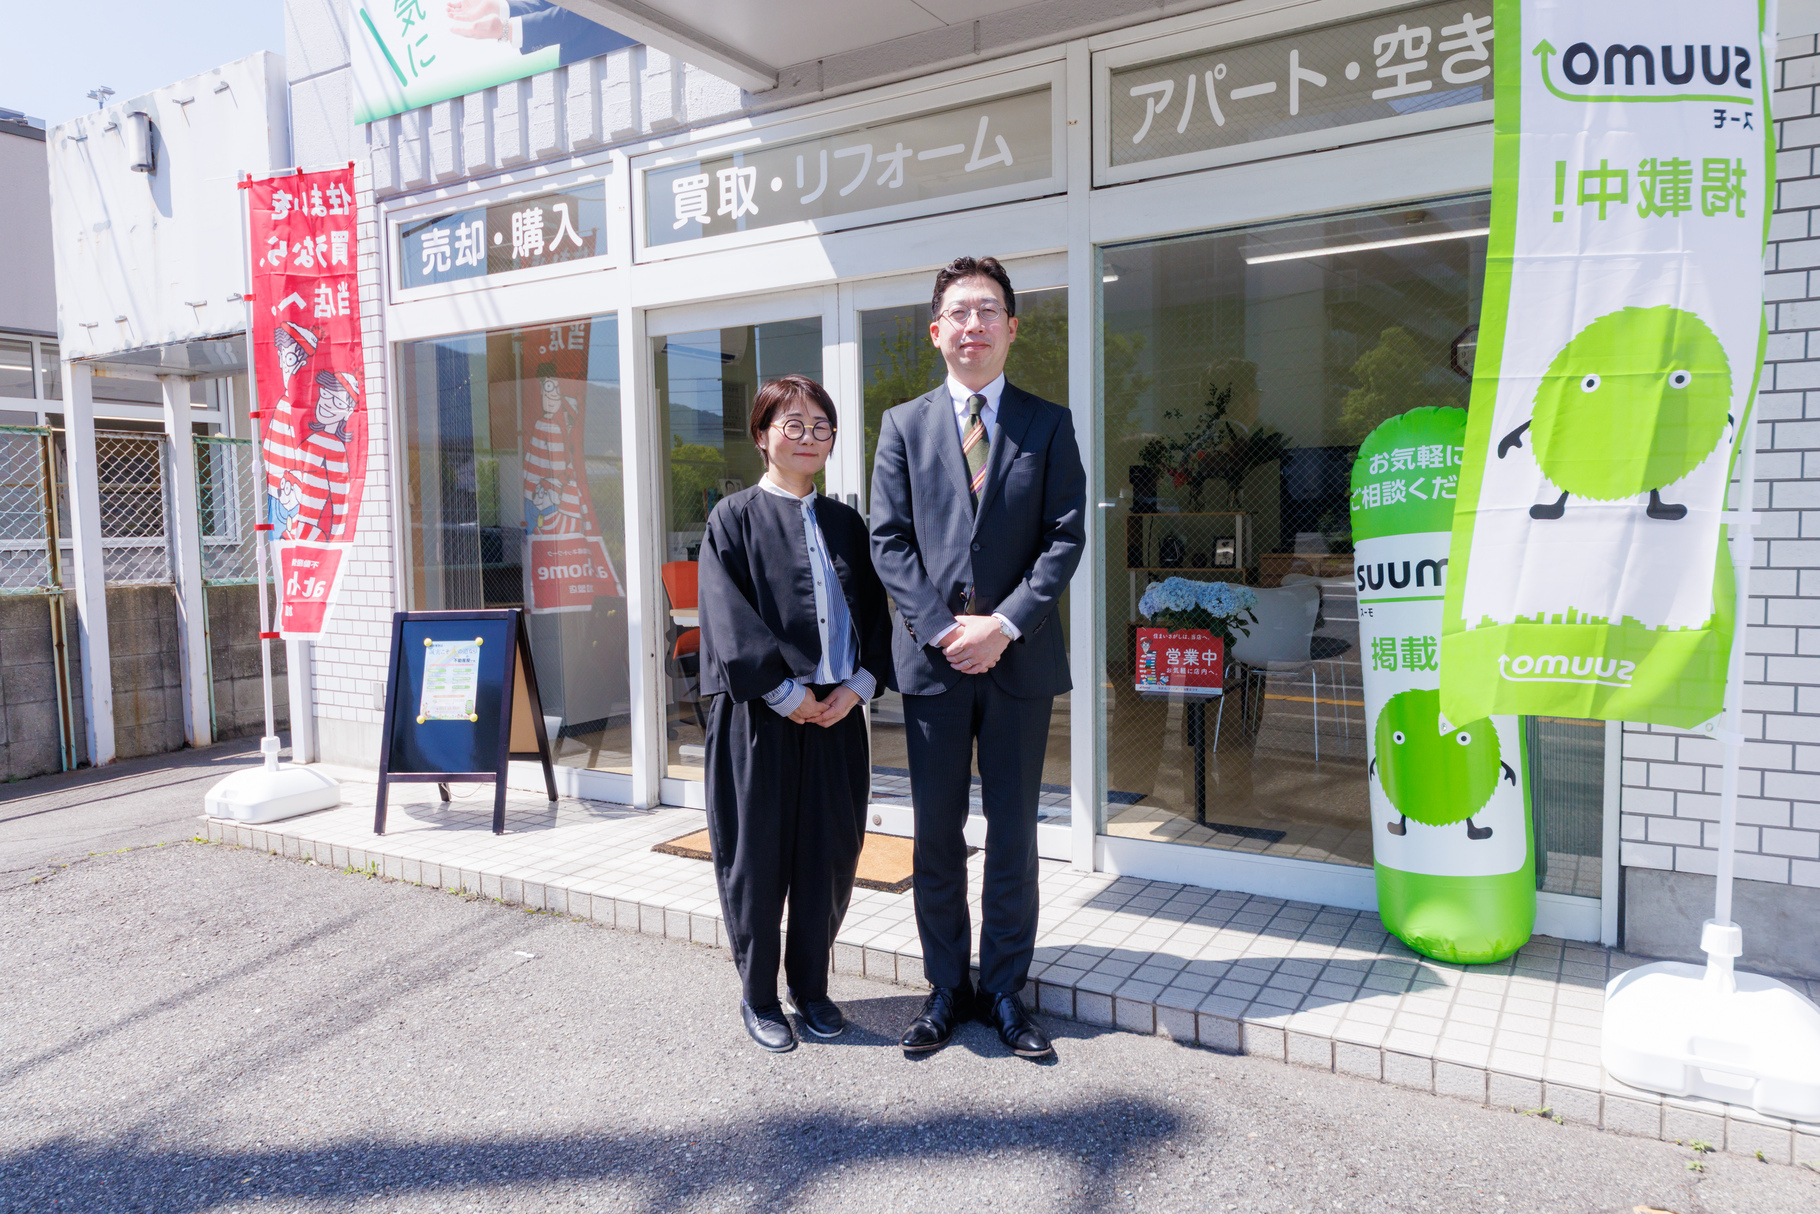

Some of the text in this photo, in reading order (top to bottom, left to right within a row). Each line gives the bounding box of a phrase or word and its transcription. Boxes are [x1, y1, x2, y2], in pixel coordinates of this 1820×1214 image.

[1129, 12, 1494, 144] アパート・空き
[672, 115, 1013, 230] 買取・リフォーム
[420, 202, 584, 276] 売却・購入
[1369, 444, 1464, 475] お気軽に
[1360, 608, 1374, 618] スーモ
[1165, 647, 1218, 667] 営業中
[1371, 635, 1439, 672] 掲載
